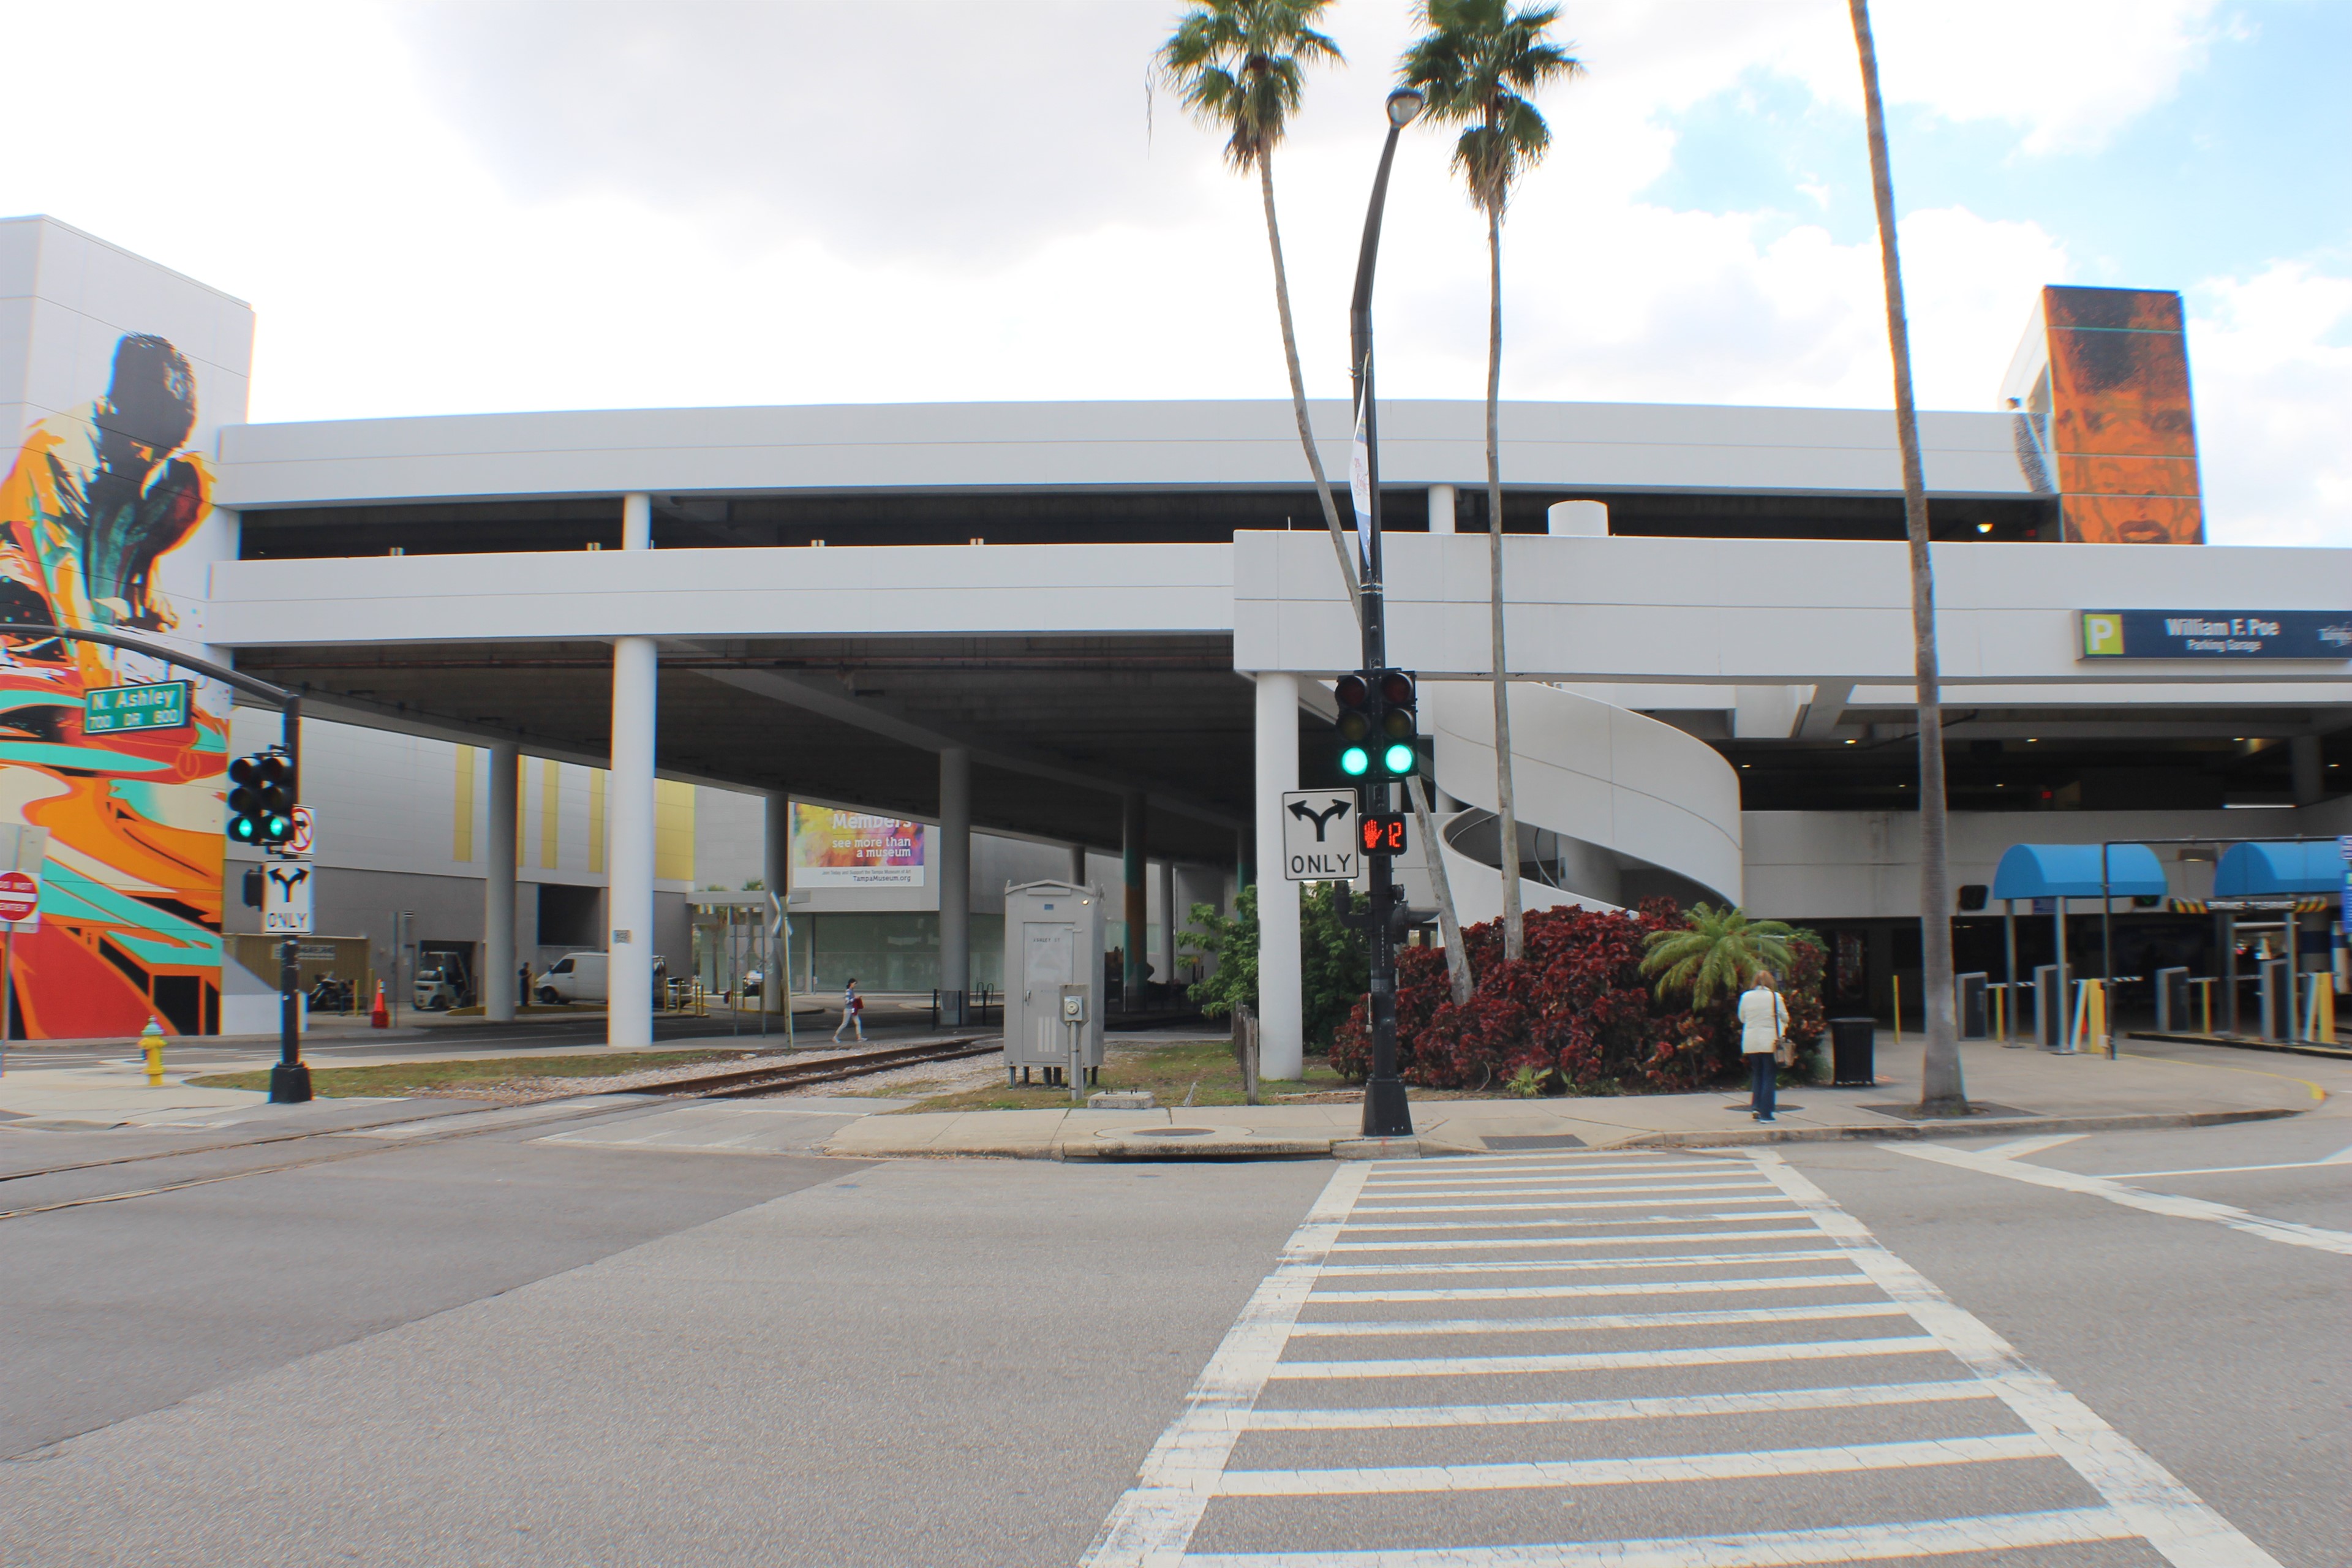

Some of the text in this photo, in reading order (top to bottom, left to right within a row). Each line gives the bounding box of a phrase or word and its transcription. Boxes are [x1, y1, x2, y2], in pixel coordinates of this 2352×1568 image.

[2089, 618, 2113, 650] P
[2165, 617, 2280, 636] William F. Poe
[2185, 639, 2263, 652] Parking Garage
[92, 689, 177, 710] N. Ashley
[89, 715, 115, 729] 700
[124, 712, 143, 726] DR
[832, 837, 911, 848] see more than
[1388, 822, 1402, 848] 12
[866, 848, 911, 857] museum
[1291, 853, 1351, 873] ONLY
[13, 882, 33, 891] NOT
[267, 912, 309, 928] ONLY
